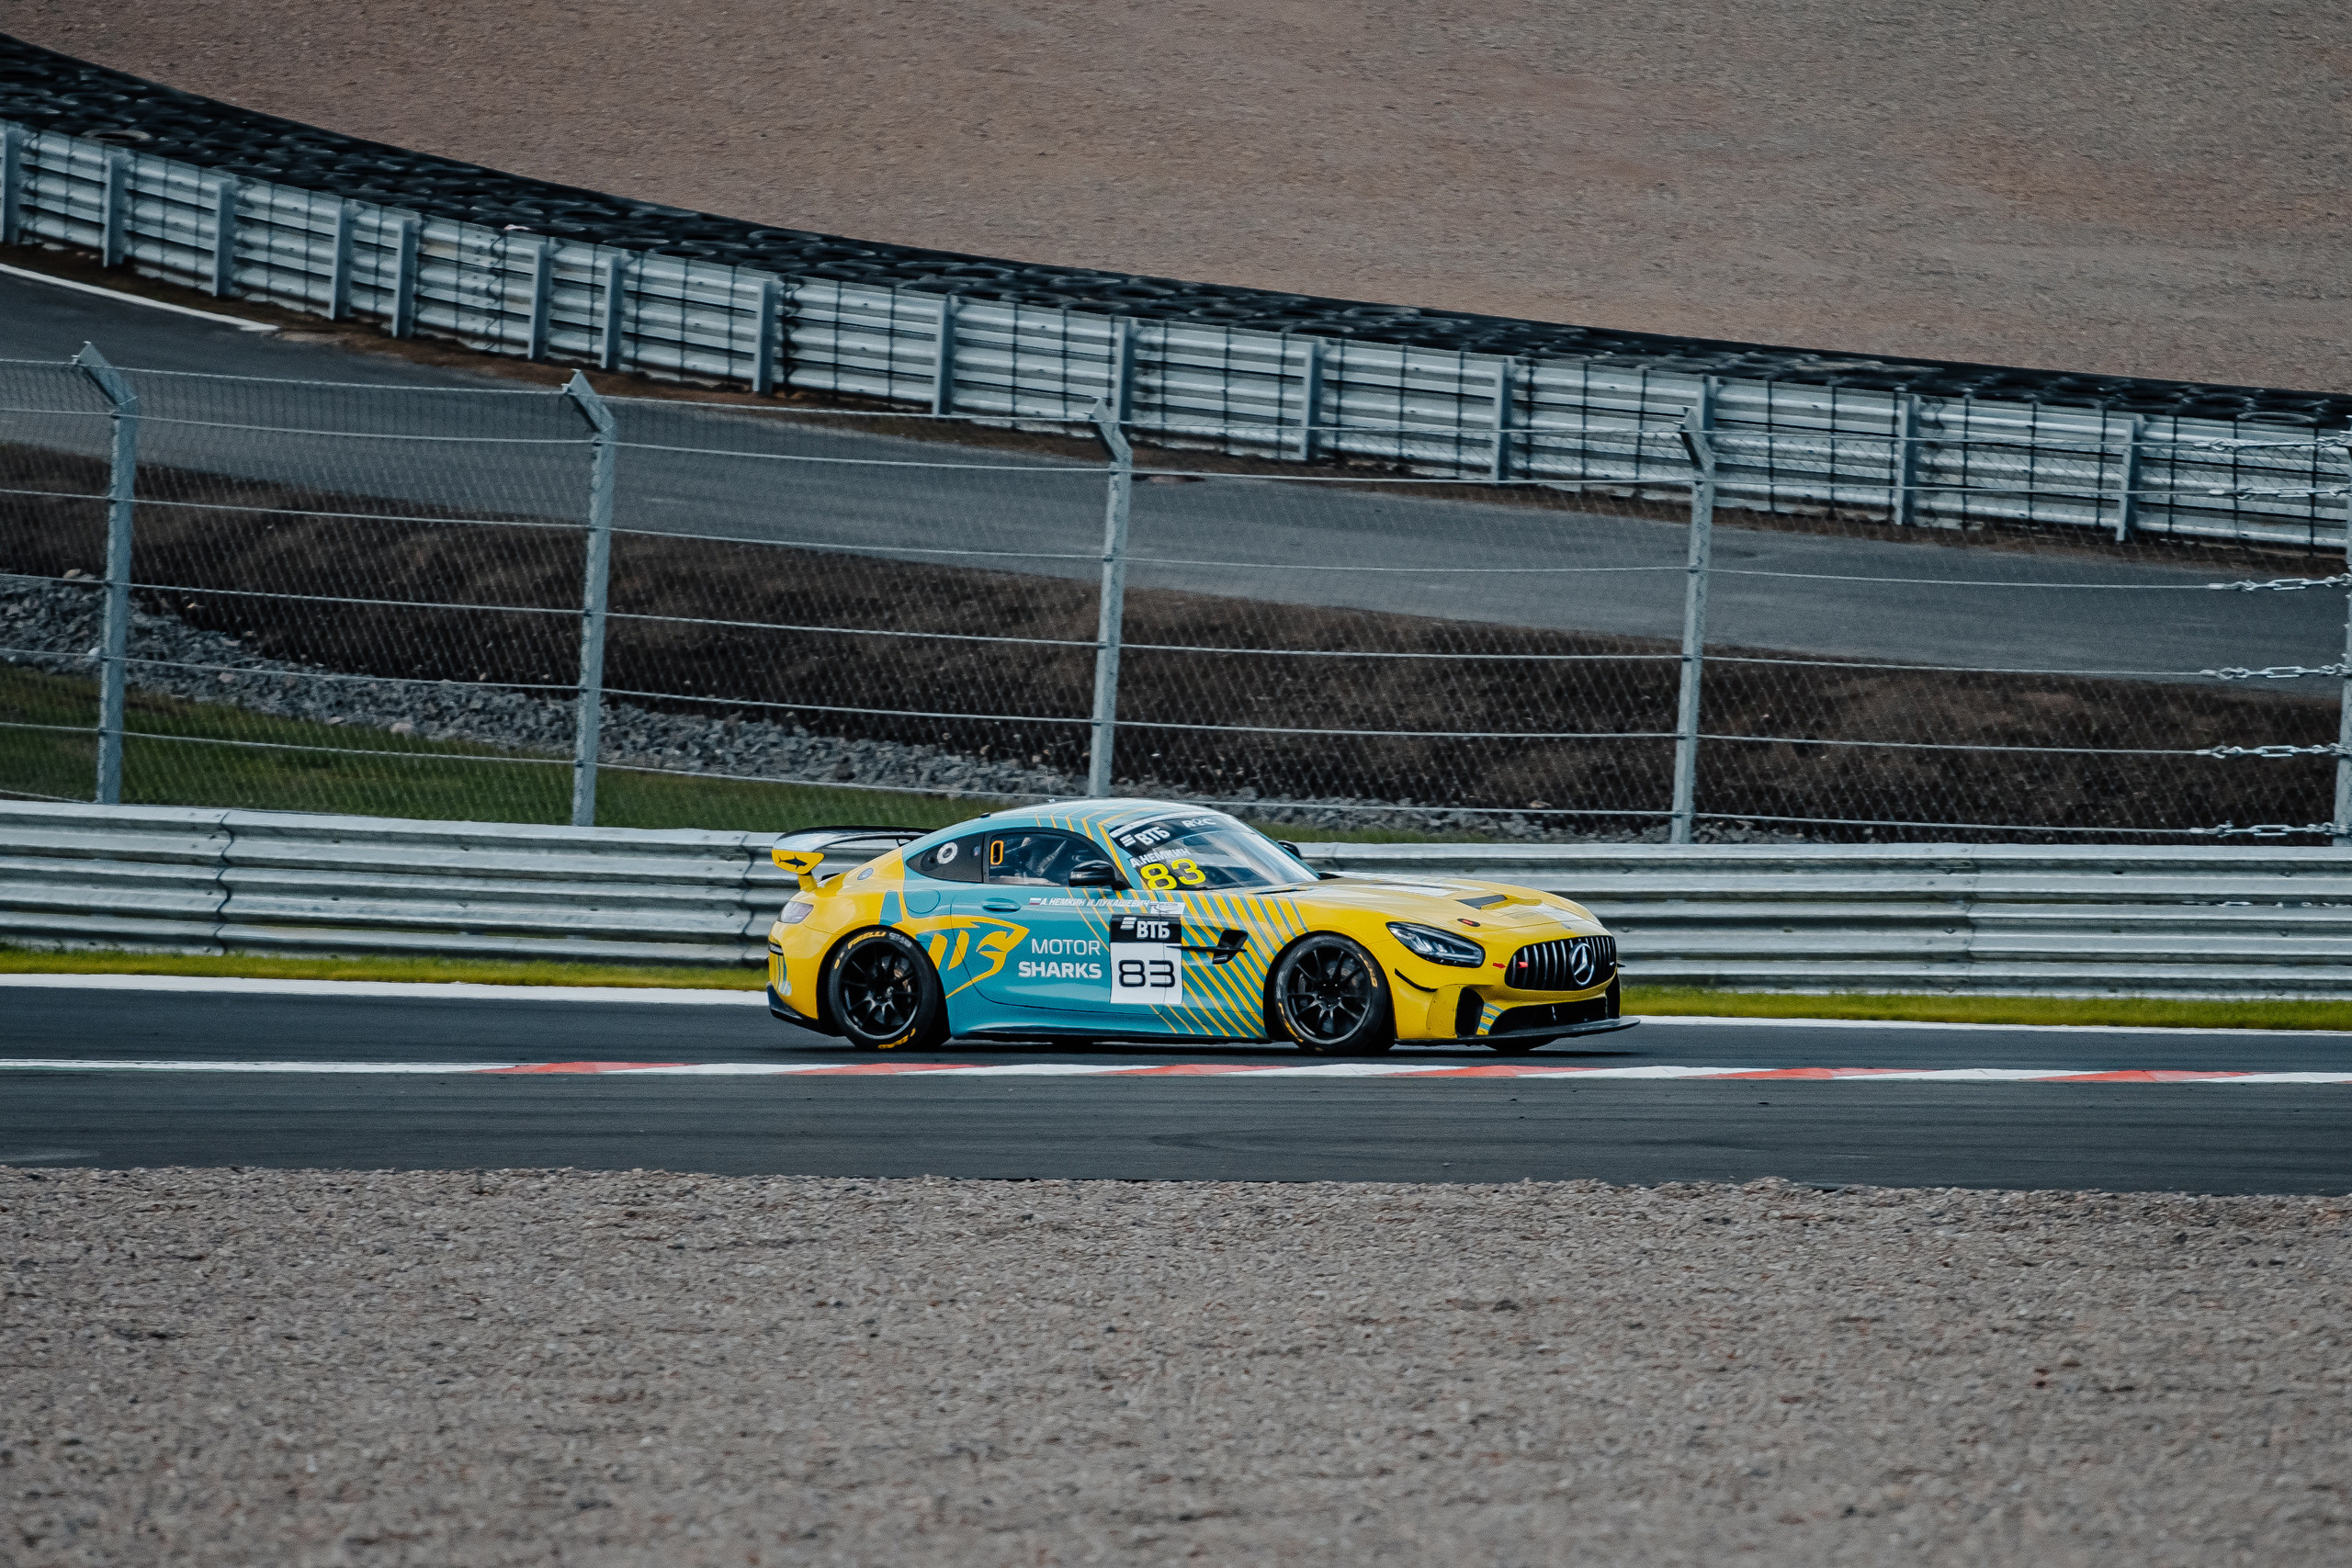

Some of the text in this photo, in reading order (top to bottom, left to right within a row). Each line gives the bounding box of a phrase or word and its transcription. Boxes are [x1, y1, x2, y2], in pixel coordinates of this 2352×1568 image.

[1134, 826, 1171, 847] ВТБ
[1140, 858, 1206, 890] 83
[1136, 920, 1171, 940] ВТБ
[1031, 938, 1102, 956] MOTOR
[1018, 961, 1102, 979] SHARKS
[1118, 959, 1176, 988] 83
